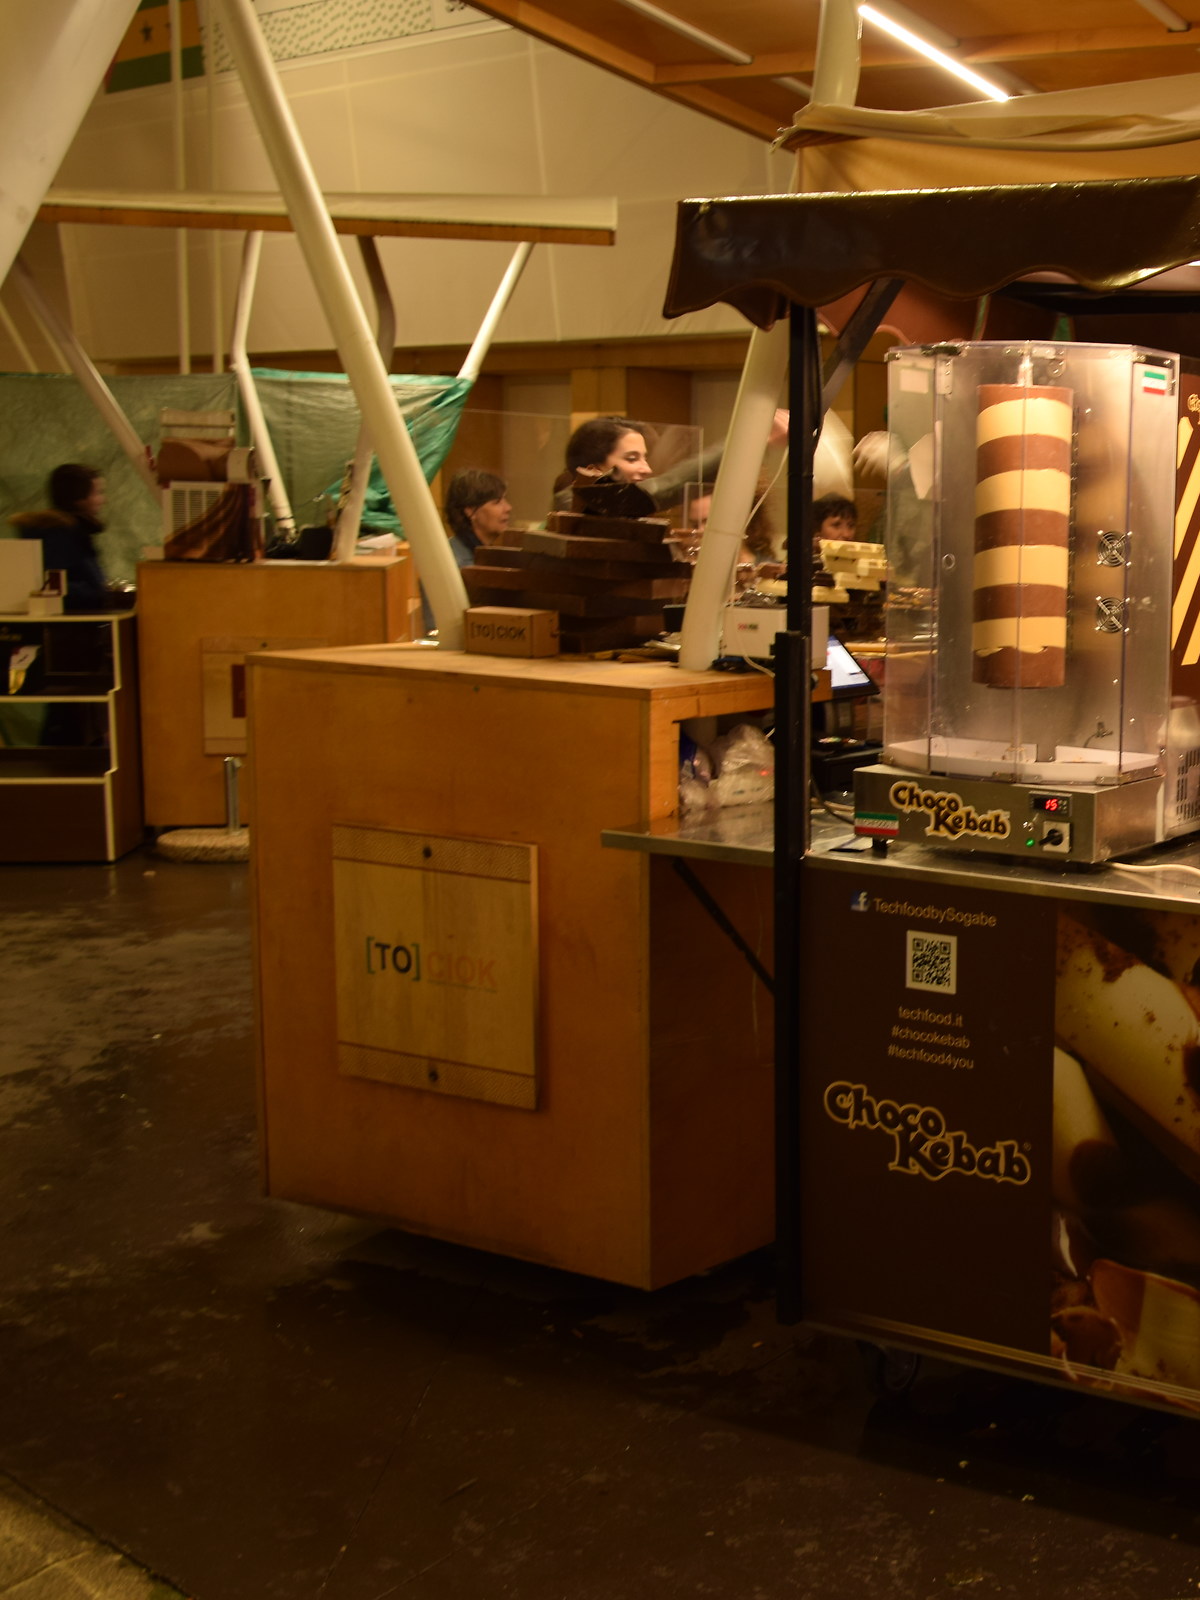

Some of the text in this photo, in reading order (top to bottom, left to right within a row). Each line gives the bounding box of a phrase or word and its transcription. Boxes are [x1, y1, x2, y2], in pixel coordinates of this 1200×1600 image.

[889, 780, 963, 814] Choco
[925, 805, 1011, 841] Kebab
[873, 897, 998, 928] TechfoodbySogabe
[898, 1005, 964, 1028] techfood.it
[891, 1024, 971, 1050] #chocokebab
[887, 1044, 975, 1070] #techfood4you
[824, 1081, 946, 1139] Choco
[887, 1130, 1032, 1186] Kebab
